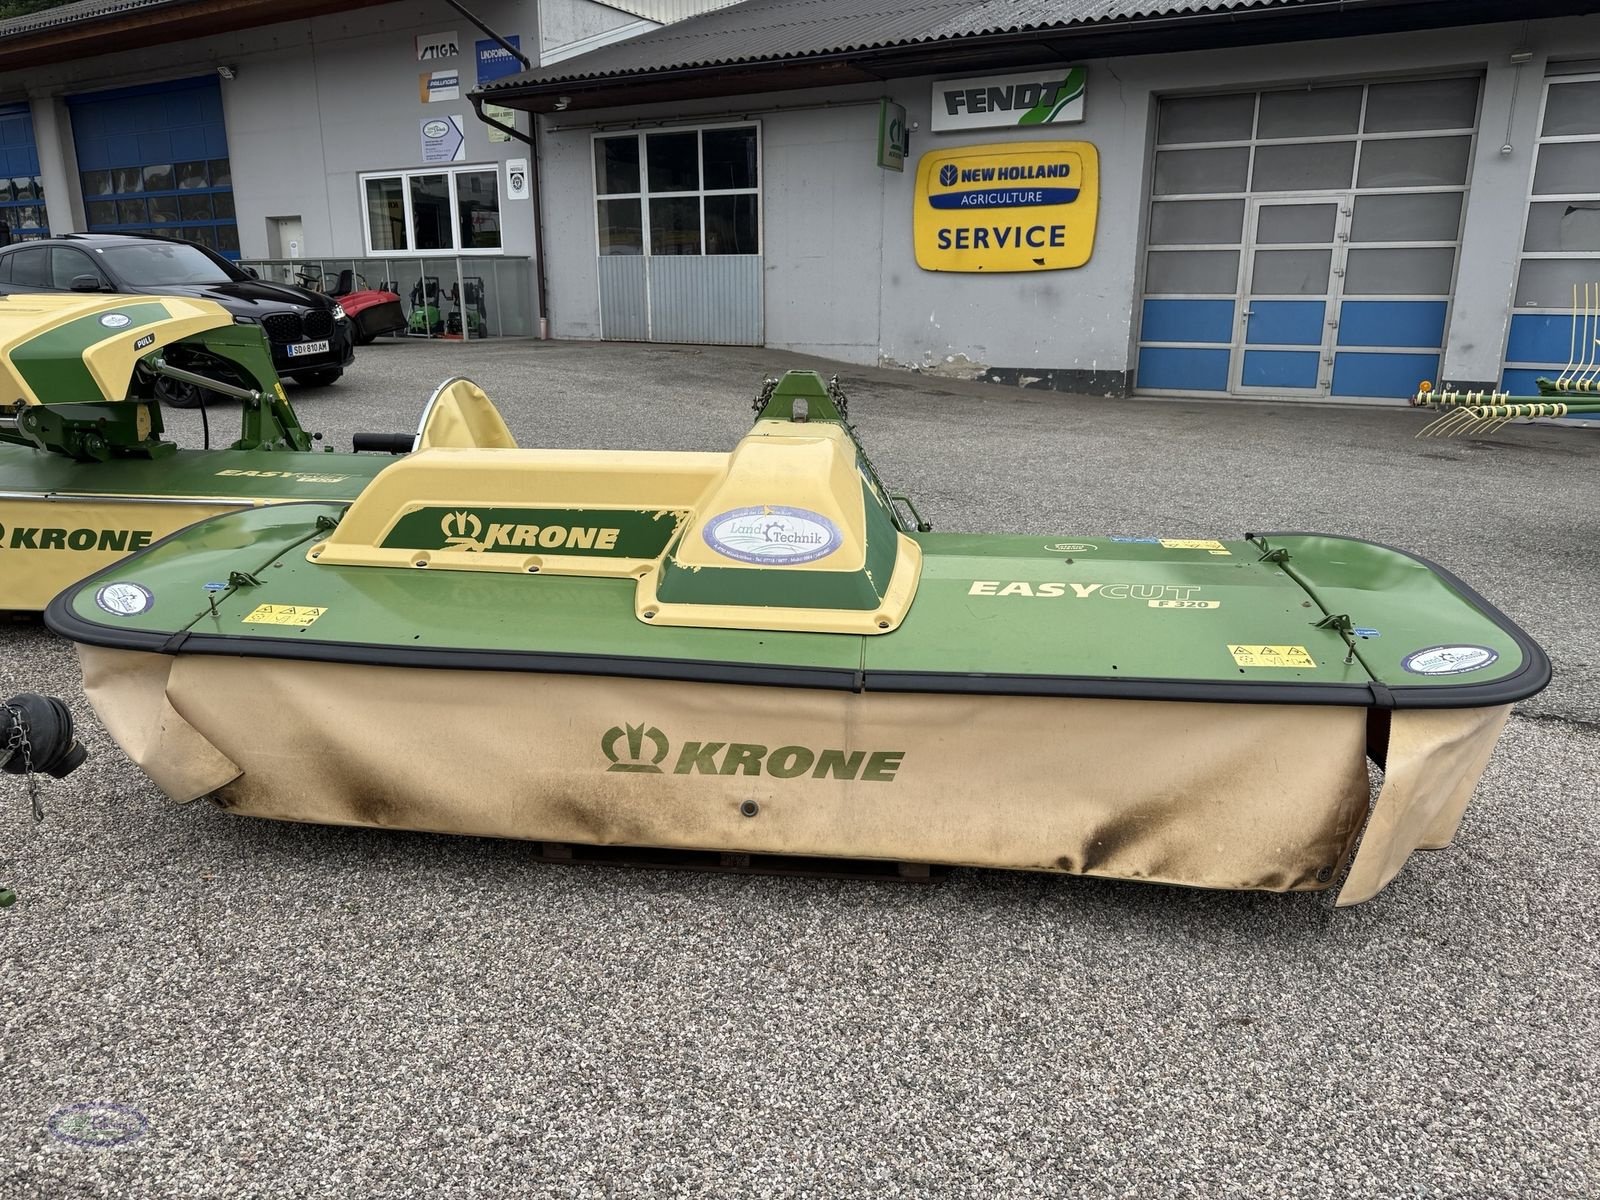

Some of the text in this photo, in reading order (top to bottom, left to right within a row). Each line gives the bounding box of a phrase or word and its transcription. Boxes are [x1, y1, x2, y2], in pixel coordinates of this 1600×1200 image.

[421, 43, 459, 60] STIGA
[943, 80, 1068, 116] FENDT
[961, 164, 1070, 182] NEW HOLLAND
[960, 191, 1043, 206] AGRICULTURE
[937, 225, 1066, 250] SERVICE
[137, 336, 152, 348] PULL
[10, 527, 153, 552] KRONE
[483, 523, 620, 550] KRONE
[730, 522, 822, 544] Land Technik
[967, 580, 1201, 600] EASYCUT
[1157, 600, 1210, 608] F 320
[673, 741, 906, 782] KRONE
